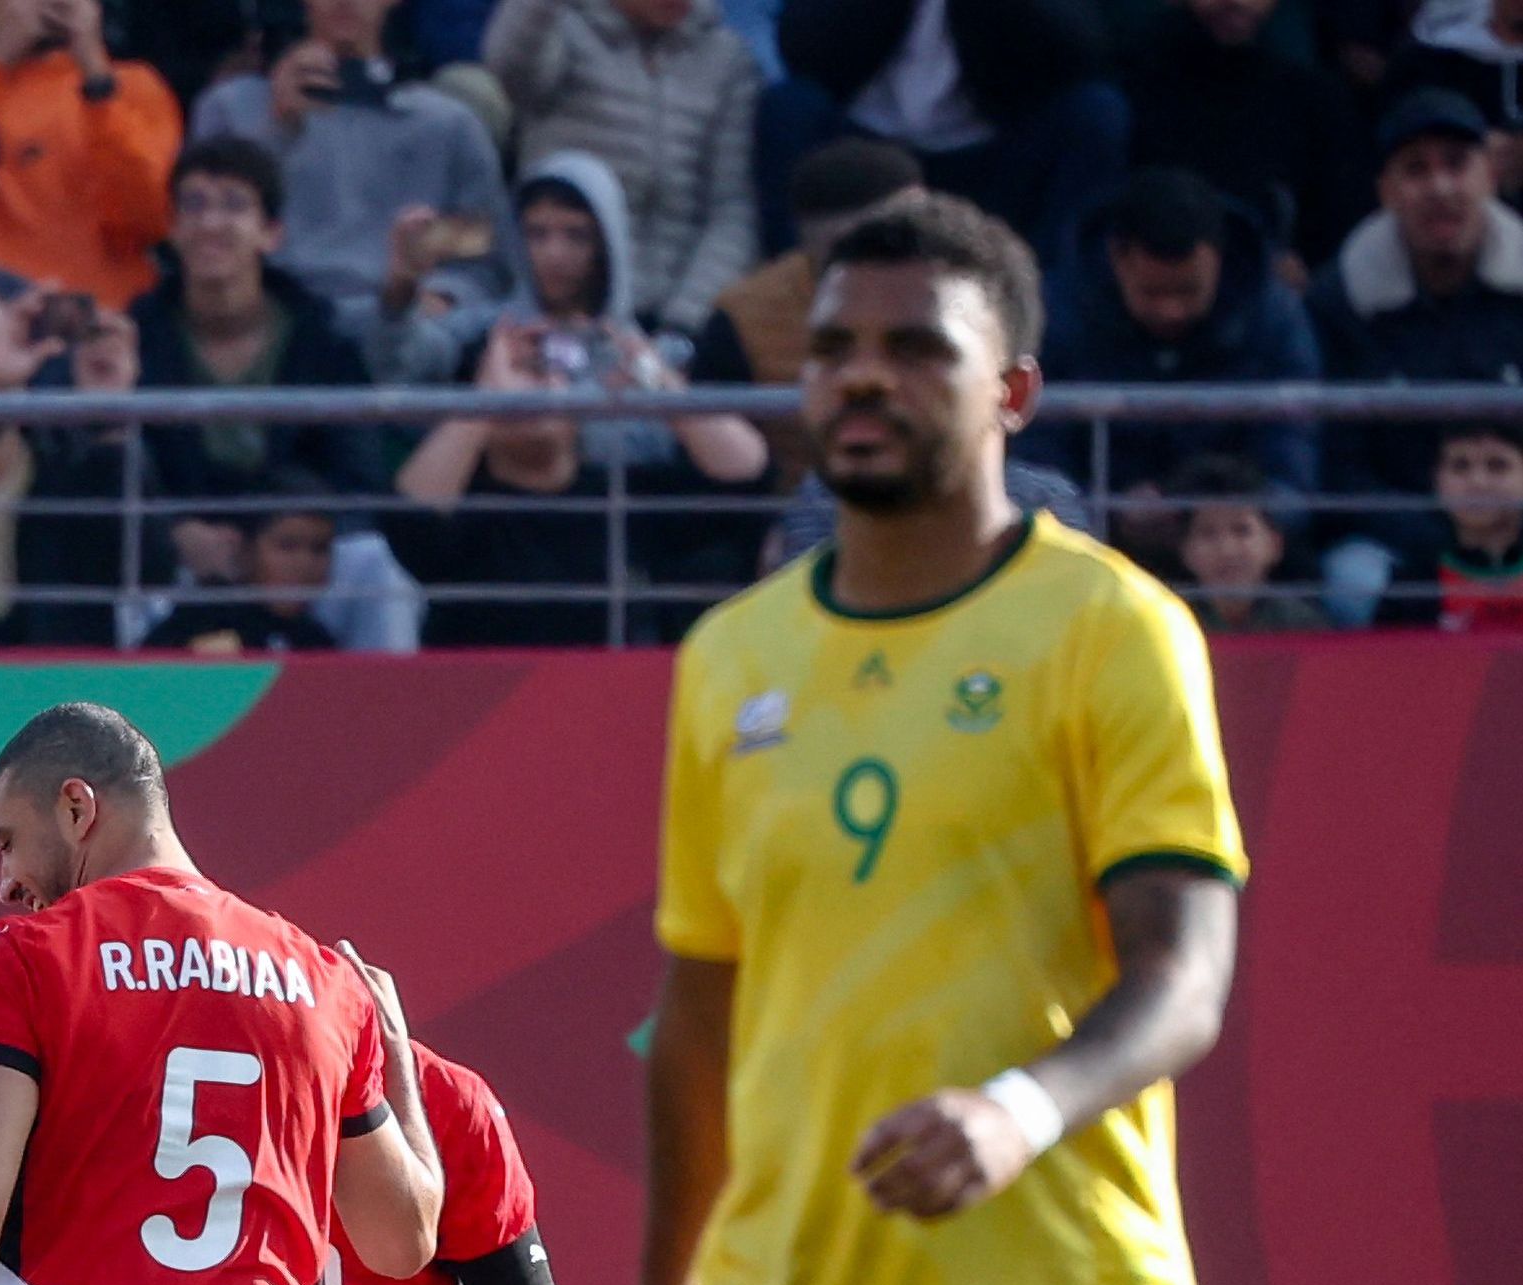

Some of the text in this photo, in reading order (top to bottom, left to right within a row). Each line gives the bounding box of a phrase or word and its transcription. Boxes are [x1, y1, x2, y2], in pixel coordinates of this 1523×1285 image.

[832, 757, 900, 884] 9
[99, 938, 317, 1009] R.RABIAA
[140, 1046, 263, 1273] 5
